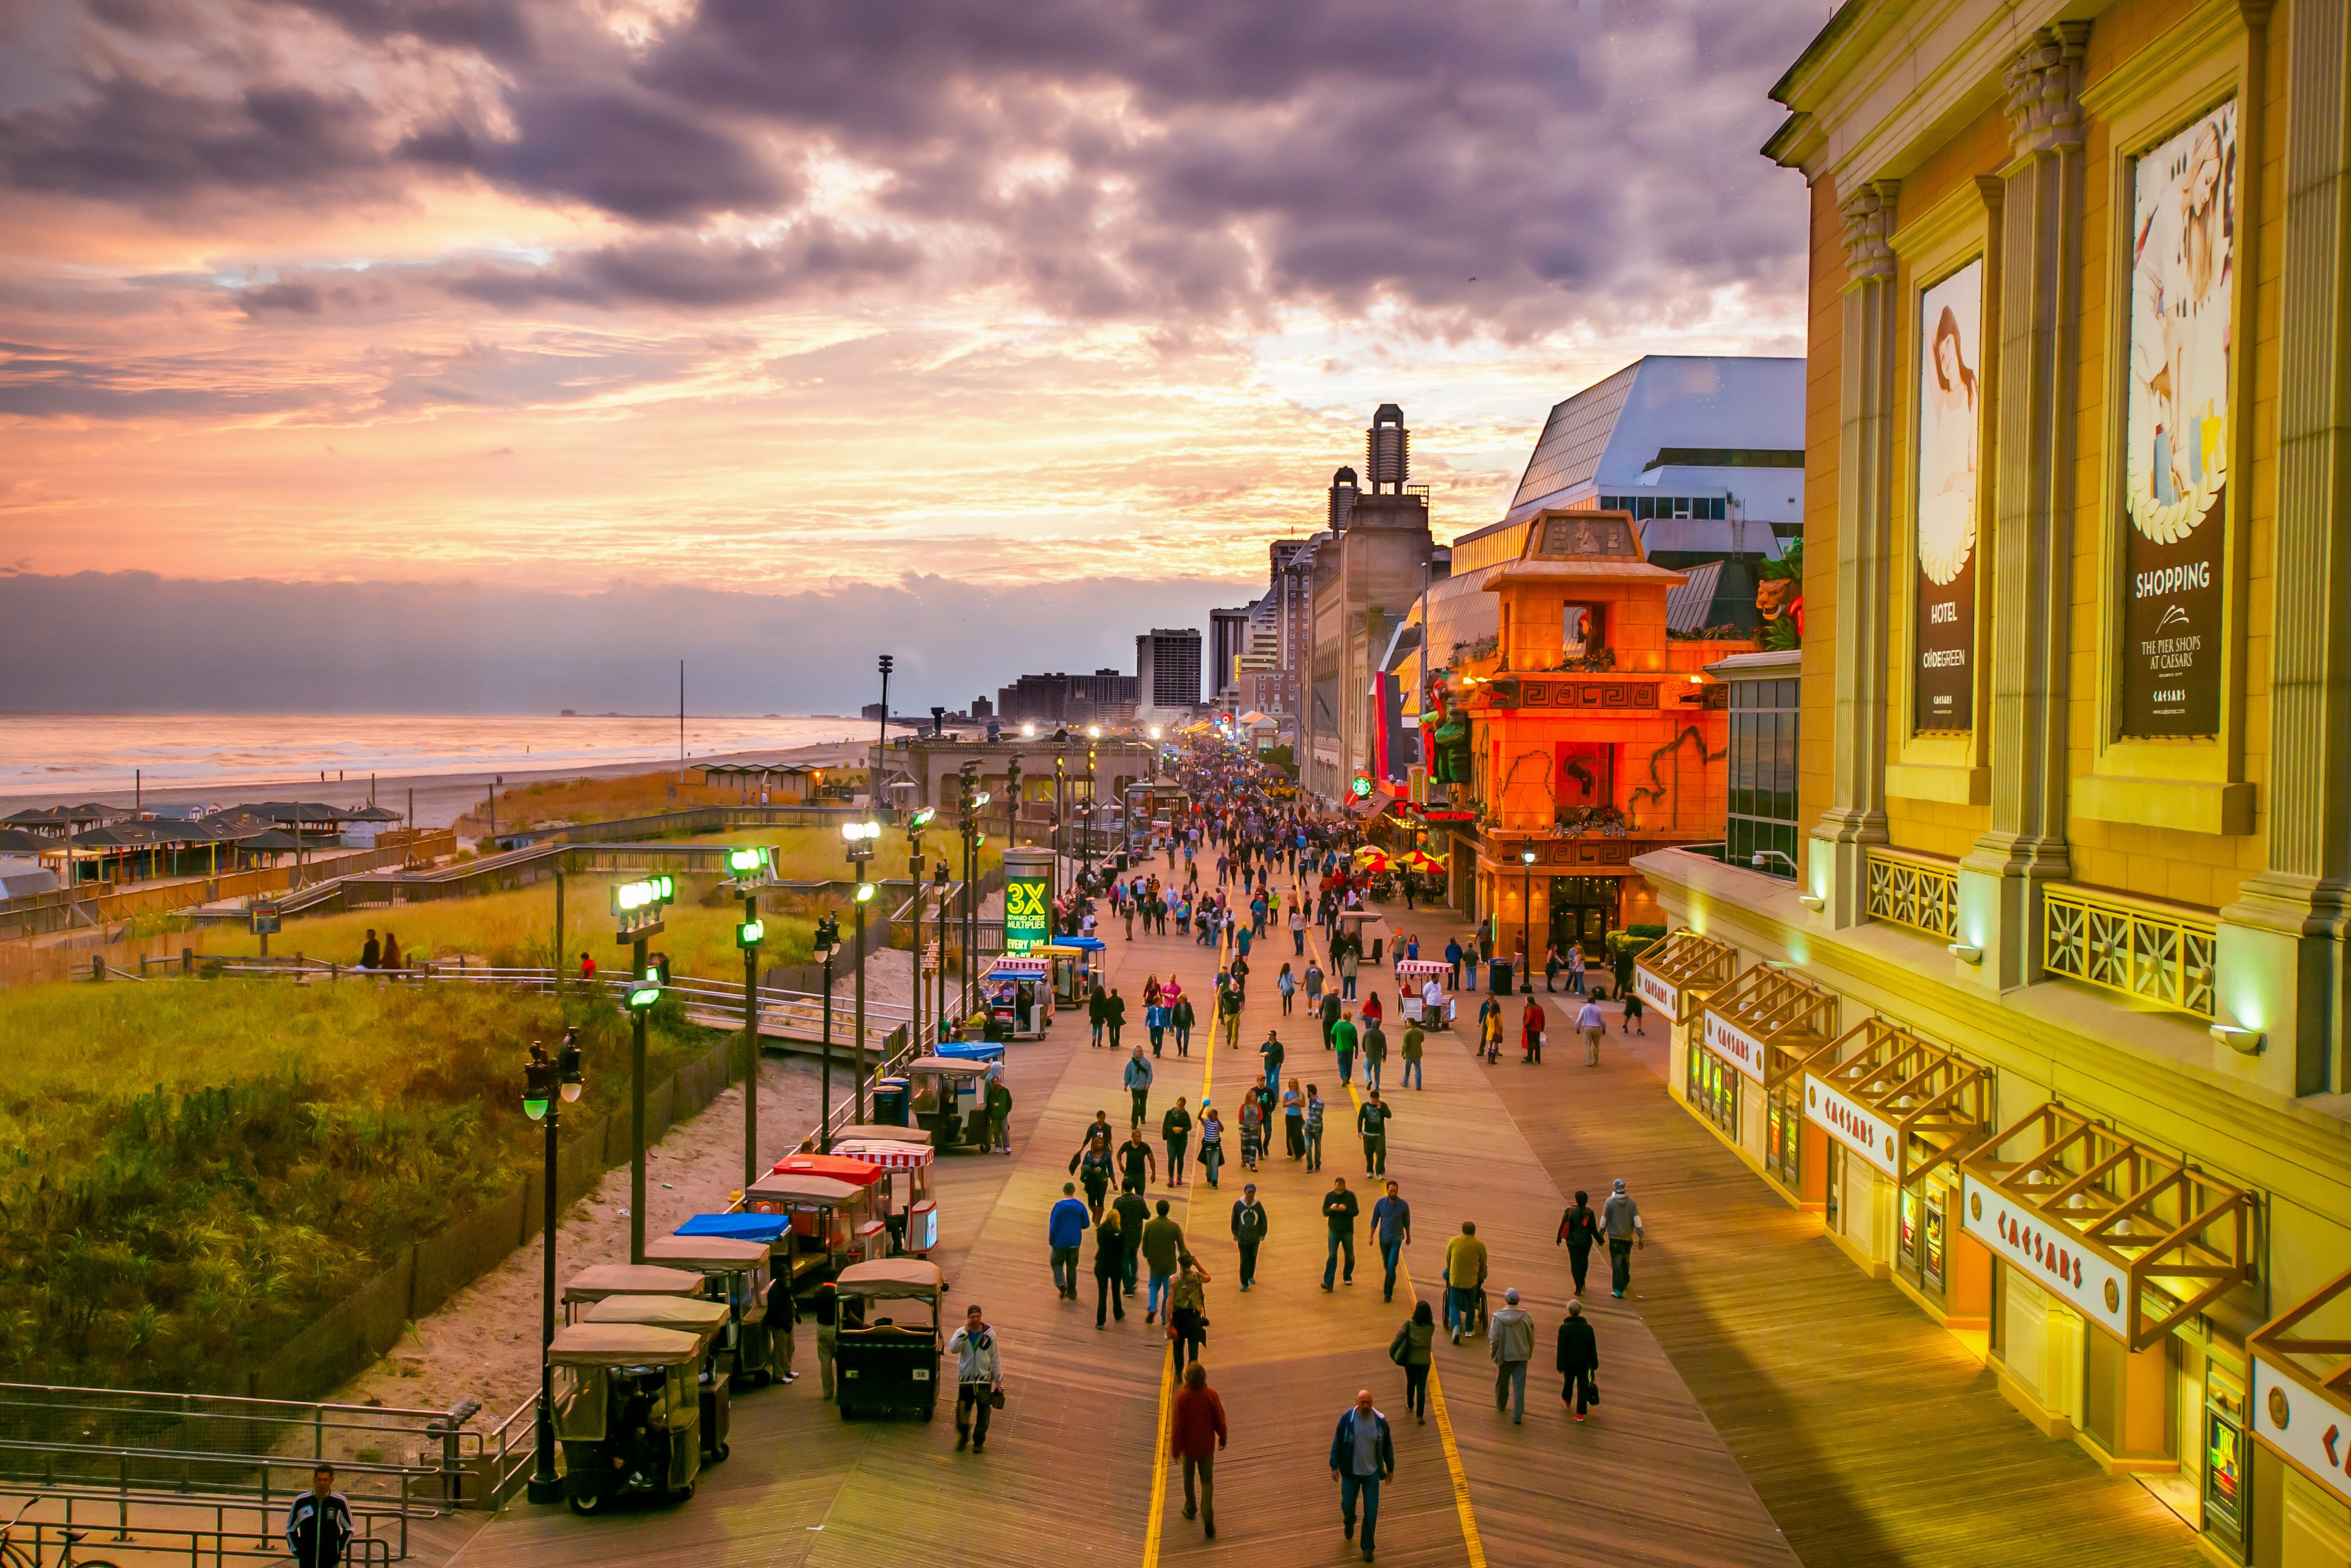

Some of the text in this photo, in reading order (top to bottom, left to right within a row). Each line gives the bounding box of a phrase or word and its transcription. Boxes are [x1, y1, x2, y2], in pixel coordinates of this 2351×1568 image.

[2136, 561, 2210, 598] SHOPPING
[1931, 601, 1957, 624] HOTEL
[2142, 635, 2201, 655] THE PIER SHOPS
[2150, 652, 2192, 670] AT CAESARS
[1934, 695, 1952, 705] CAESARS
[2153, 689, 2186, 702] CAESARS
[1007, 883, 1046, 914] 3X
[1007, 921, 1045, 929] MULTIPLIER
[1007, 939, 1028, 950] EVERY
[1645, 977, 1667, 1005] CAESARS
[1718, 1025, 1749, 1063] CAESARS
[1825, 1096, 1874, 1148] CAESARS
[1998, 1210, 2083, 1289] CAESARS
